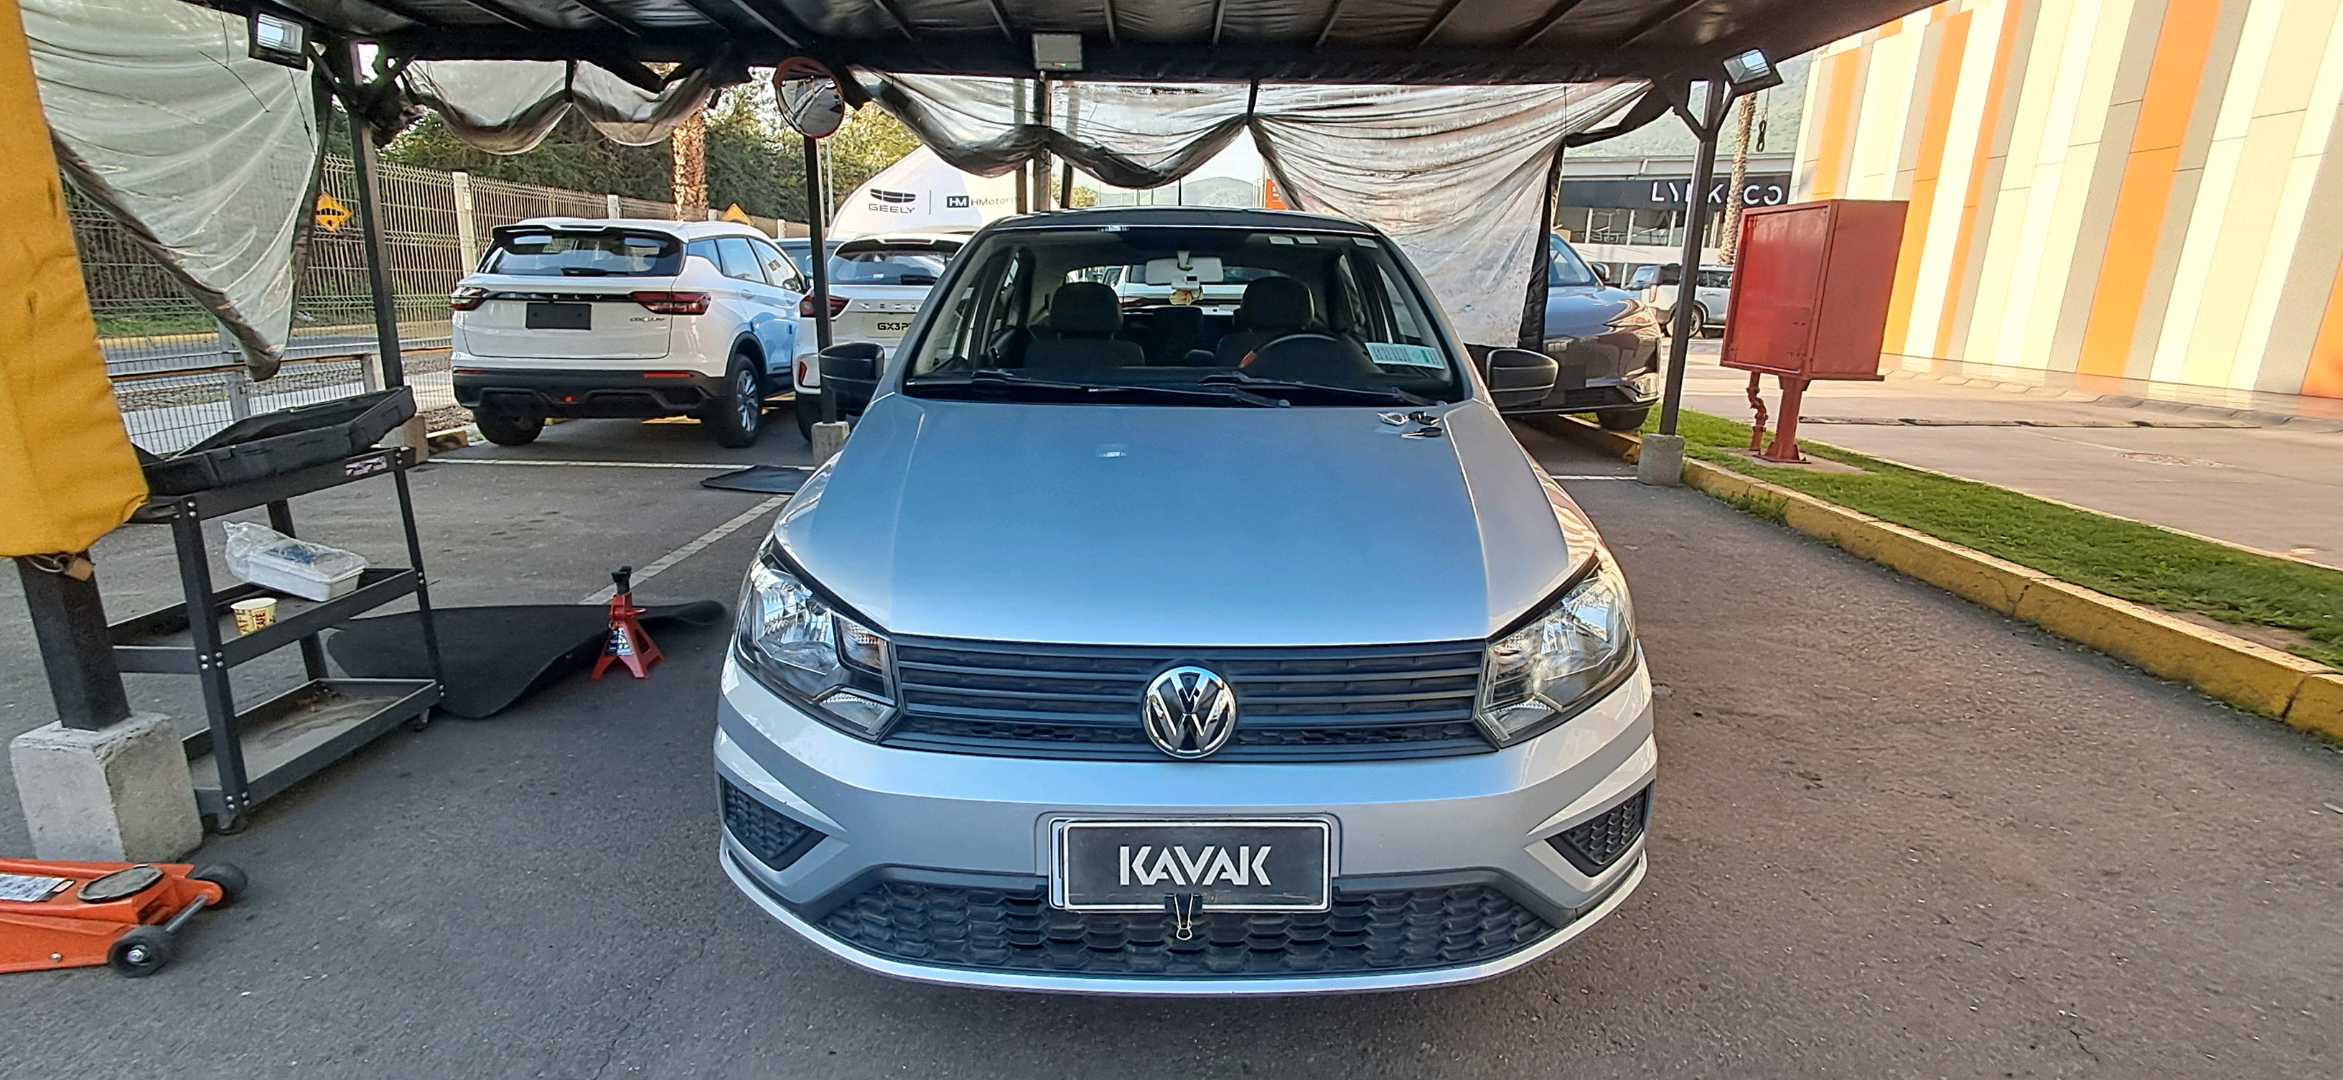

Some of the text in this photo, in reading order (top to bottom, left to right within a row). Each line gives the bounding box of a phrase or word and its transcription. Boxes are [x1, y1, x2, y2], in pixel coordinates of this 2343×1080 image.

[1651, 181, 1724, 204] LYK
[948, 197, 968, 207] HM
[868, 203, 916, 214] GEELY
[877, 322, 911, 331] GX3P
[1120, 846, 1271, 886] KAVAK
